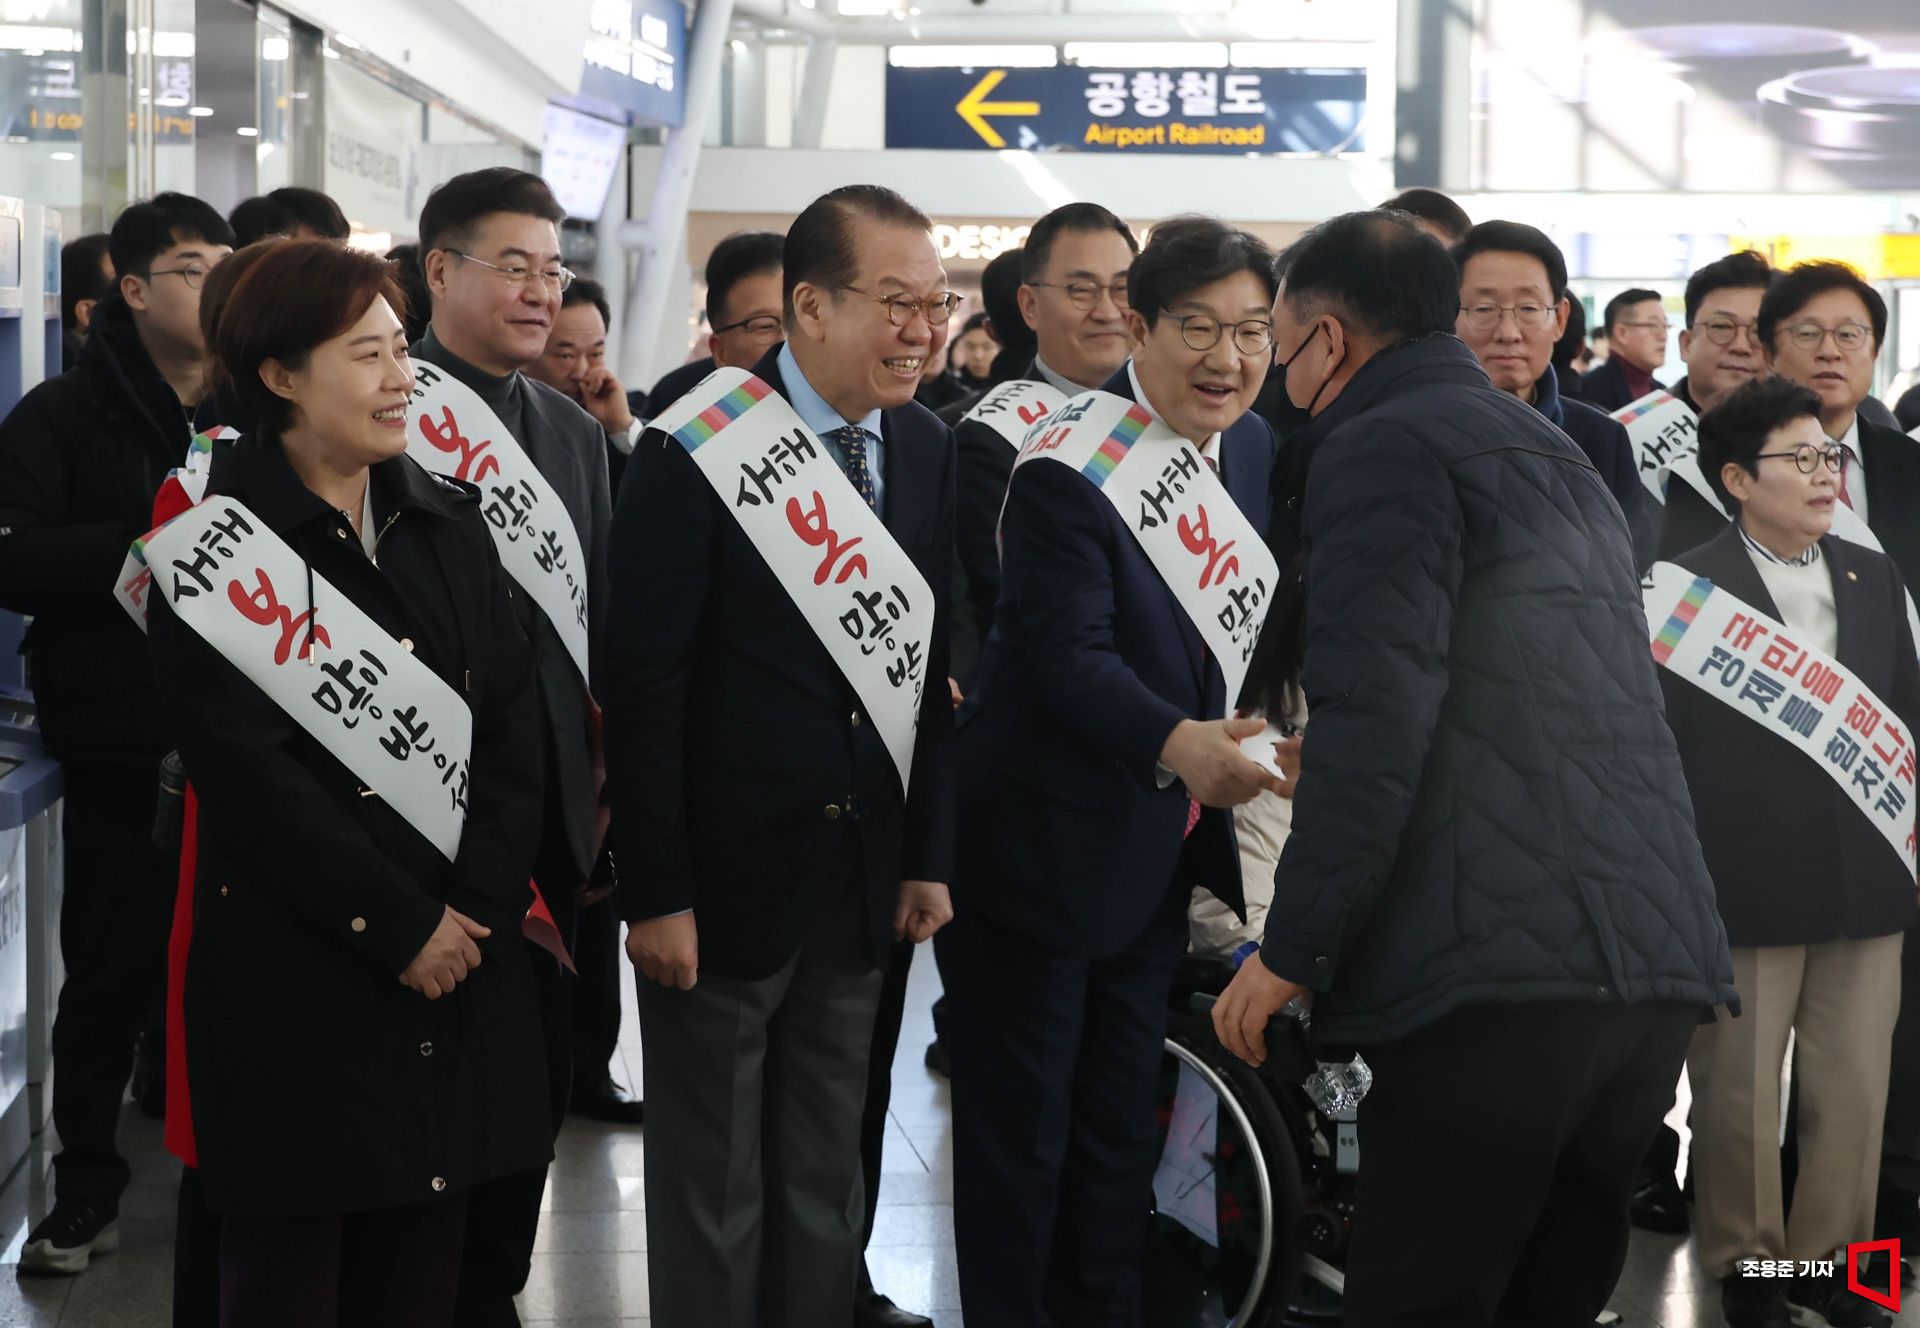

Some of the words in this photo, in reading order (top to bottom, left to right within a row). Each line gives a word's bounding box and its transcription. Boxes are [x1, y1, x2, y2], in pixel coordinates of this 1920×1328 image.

[1084, 71, 1266, 117] 공항철도
[1084, 123, 1165, 148] Airport
[1169, 122, 1265, 145] Railroad
[418, 405, 500, 483] 복
[483, 479, 538, 543] 많이
[978, 383, 1034, 417] 새해
[1640, 415, 1697, 472] 새해
[172, 508, 255, 604] 새해
[228, 567, 332, 666] 복
[312, 650, 388, 730] 많이
[736, 427, 817, 508] 새해
[785, 490, 868, 586] 복
[839, 585, 910, 656] 많이
[1140, 446, 1200, 532] 새해
[1177, 504, 1240, 590] 복
[1218, 577, 1266, 644] 많이
[1699, 645, 1824, 739] 경제를
[1824, 727, 1906, 820] 힘차게
[1721, 612, 1845, 705] 국민을
[1844, 693, 1916, 786] 힘나게
